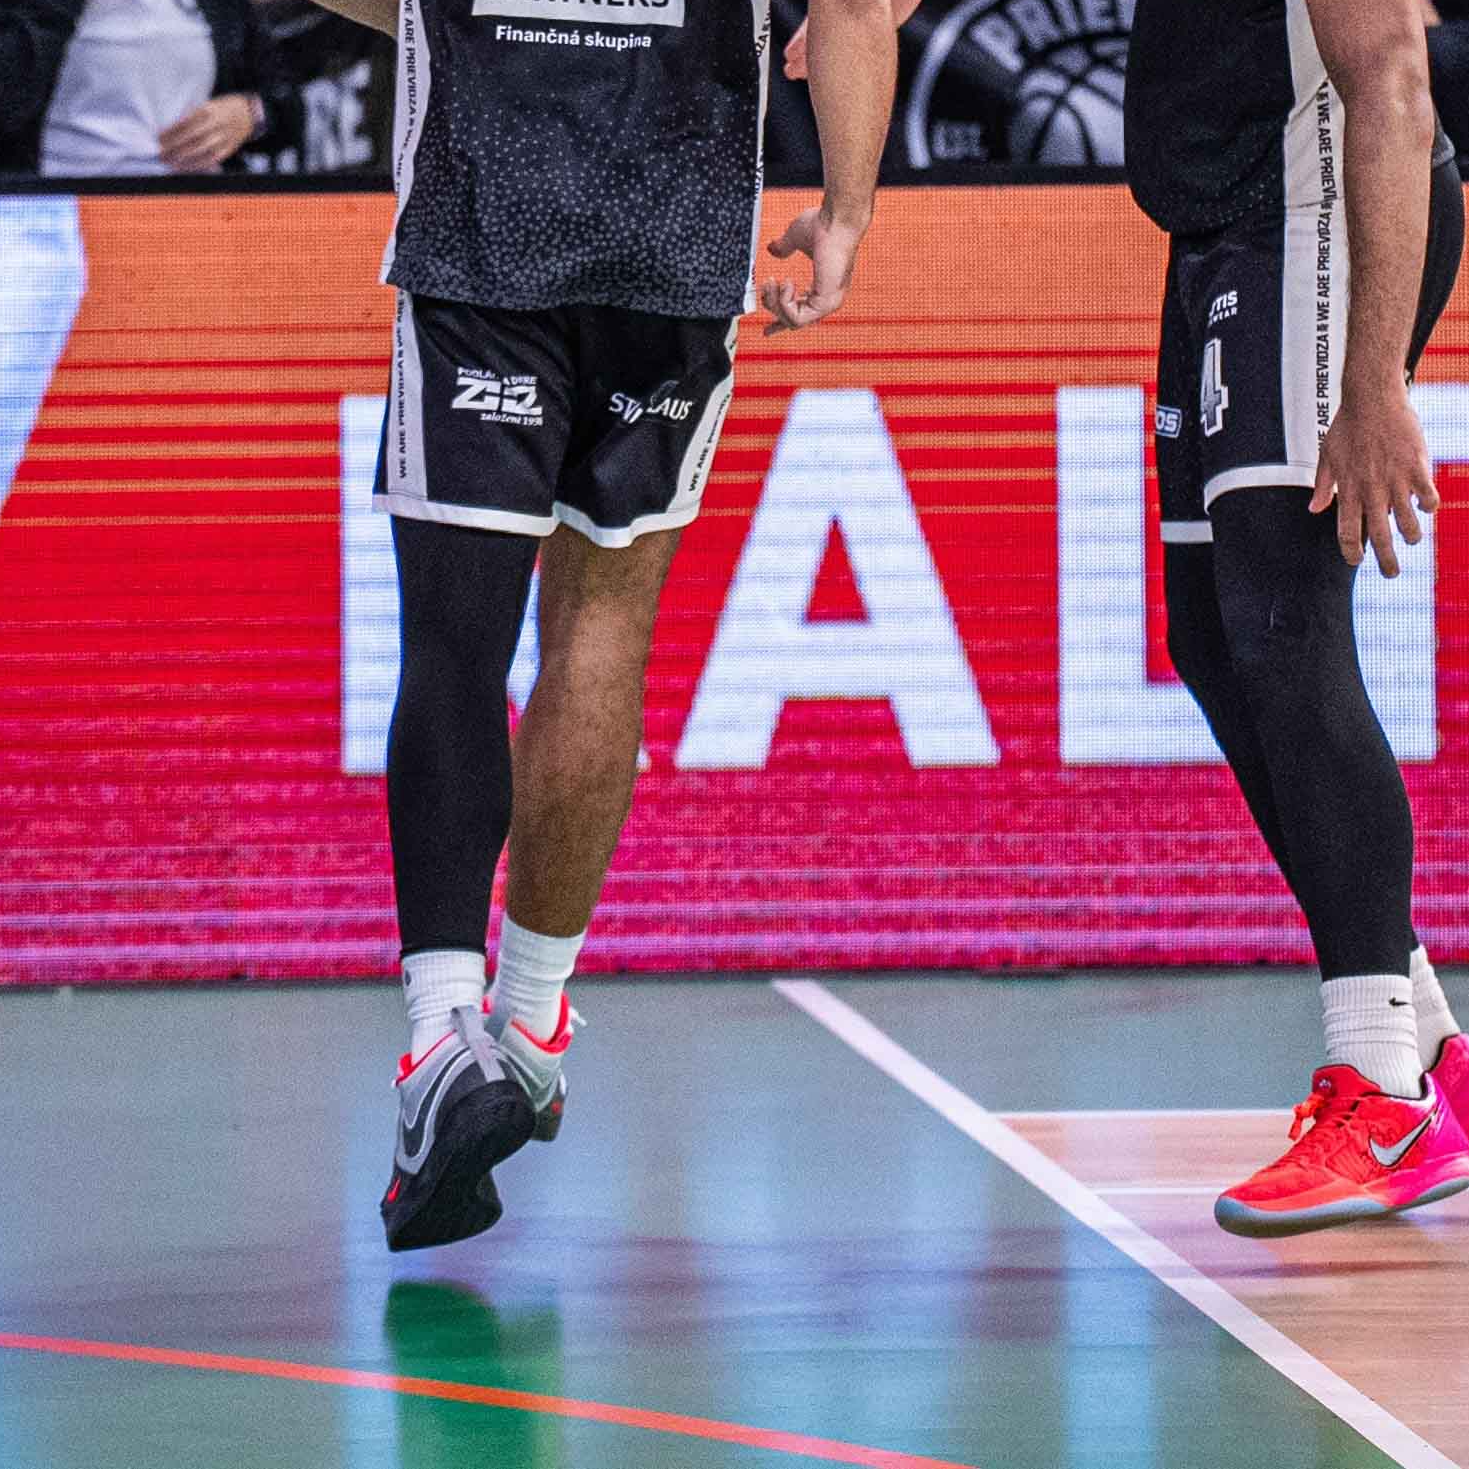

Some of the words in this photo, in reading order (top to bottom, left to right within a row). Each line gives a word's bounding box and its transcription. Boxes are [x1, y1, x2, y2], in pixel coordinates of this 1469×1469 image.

[403, 18, 415, 44] ARE
[495, 24, 580, 46] Finančná
[584, 31, 653, 52] skupina
[405, 48, 417, 115] PRIEVIDZA
[1317, 102, 1331, 126] WE
[1318, 127, 1333, 155] ARE
[1316, 273, 1331, 298] ARE
[1316, 301, 1330, 324] WE
[1316, 335, 1330, 396] PRIEVIDZA
[1200, 337, 1229, 437] 4
[1316, 401, 1330, 427] ARE
[398, 430, 407, 455] ARE
[398, 458, 408, 479] WE
